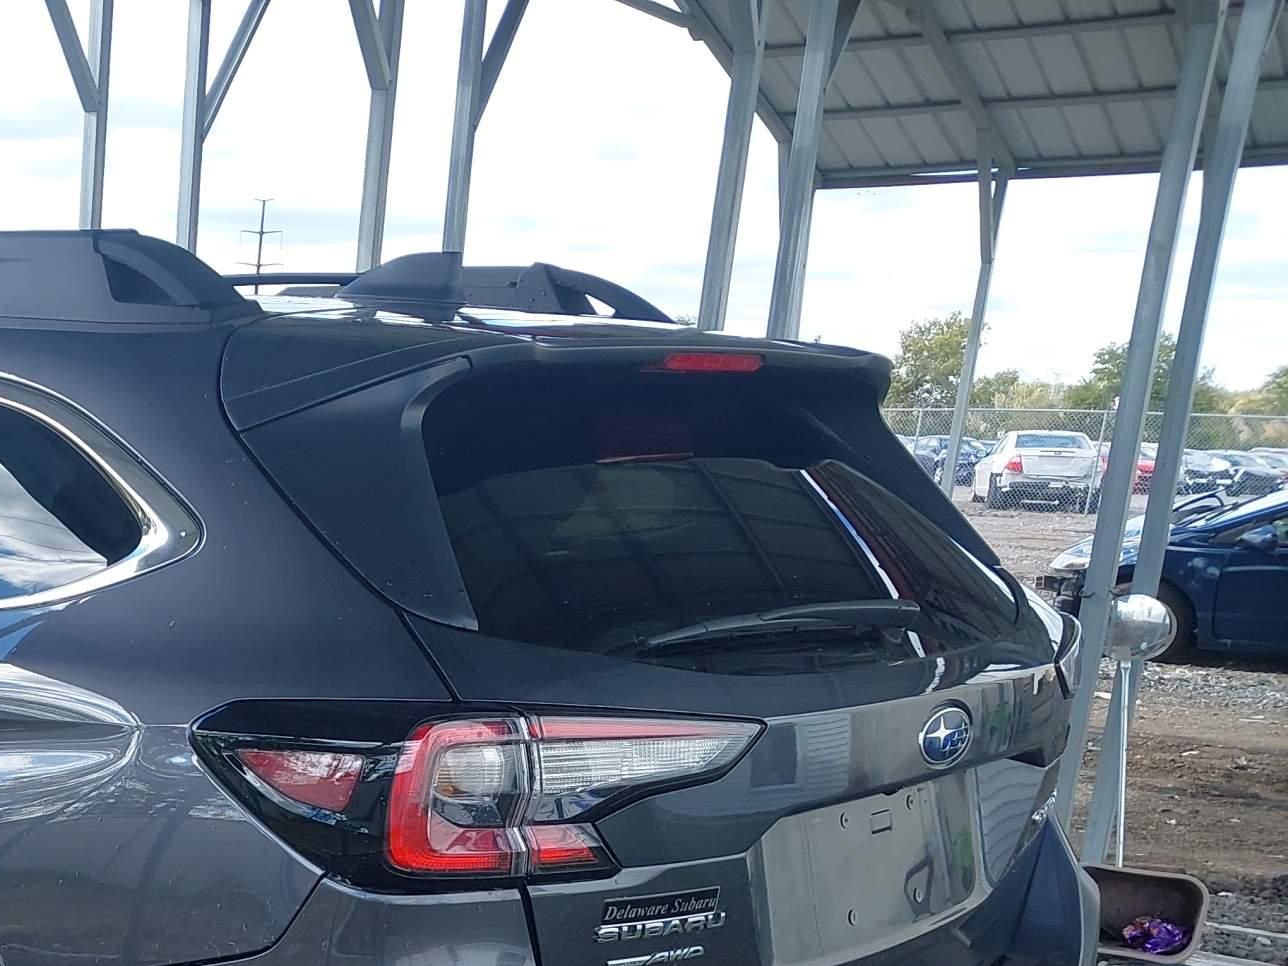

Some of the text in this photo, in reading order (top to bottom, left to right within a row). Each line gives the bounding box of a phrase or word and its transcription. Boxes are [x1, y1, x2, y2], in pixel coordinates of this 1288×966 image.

[604, 896, 717, 921] Delaware Subaru
[595, 912, 727, 943] SUBARU
[645, 945, 705, 966] AWD
